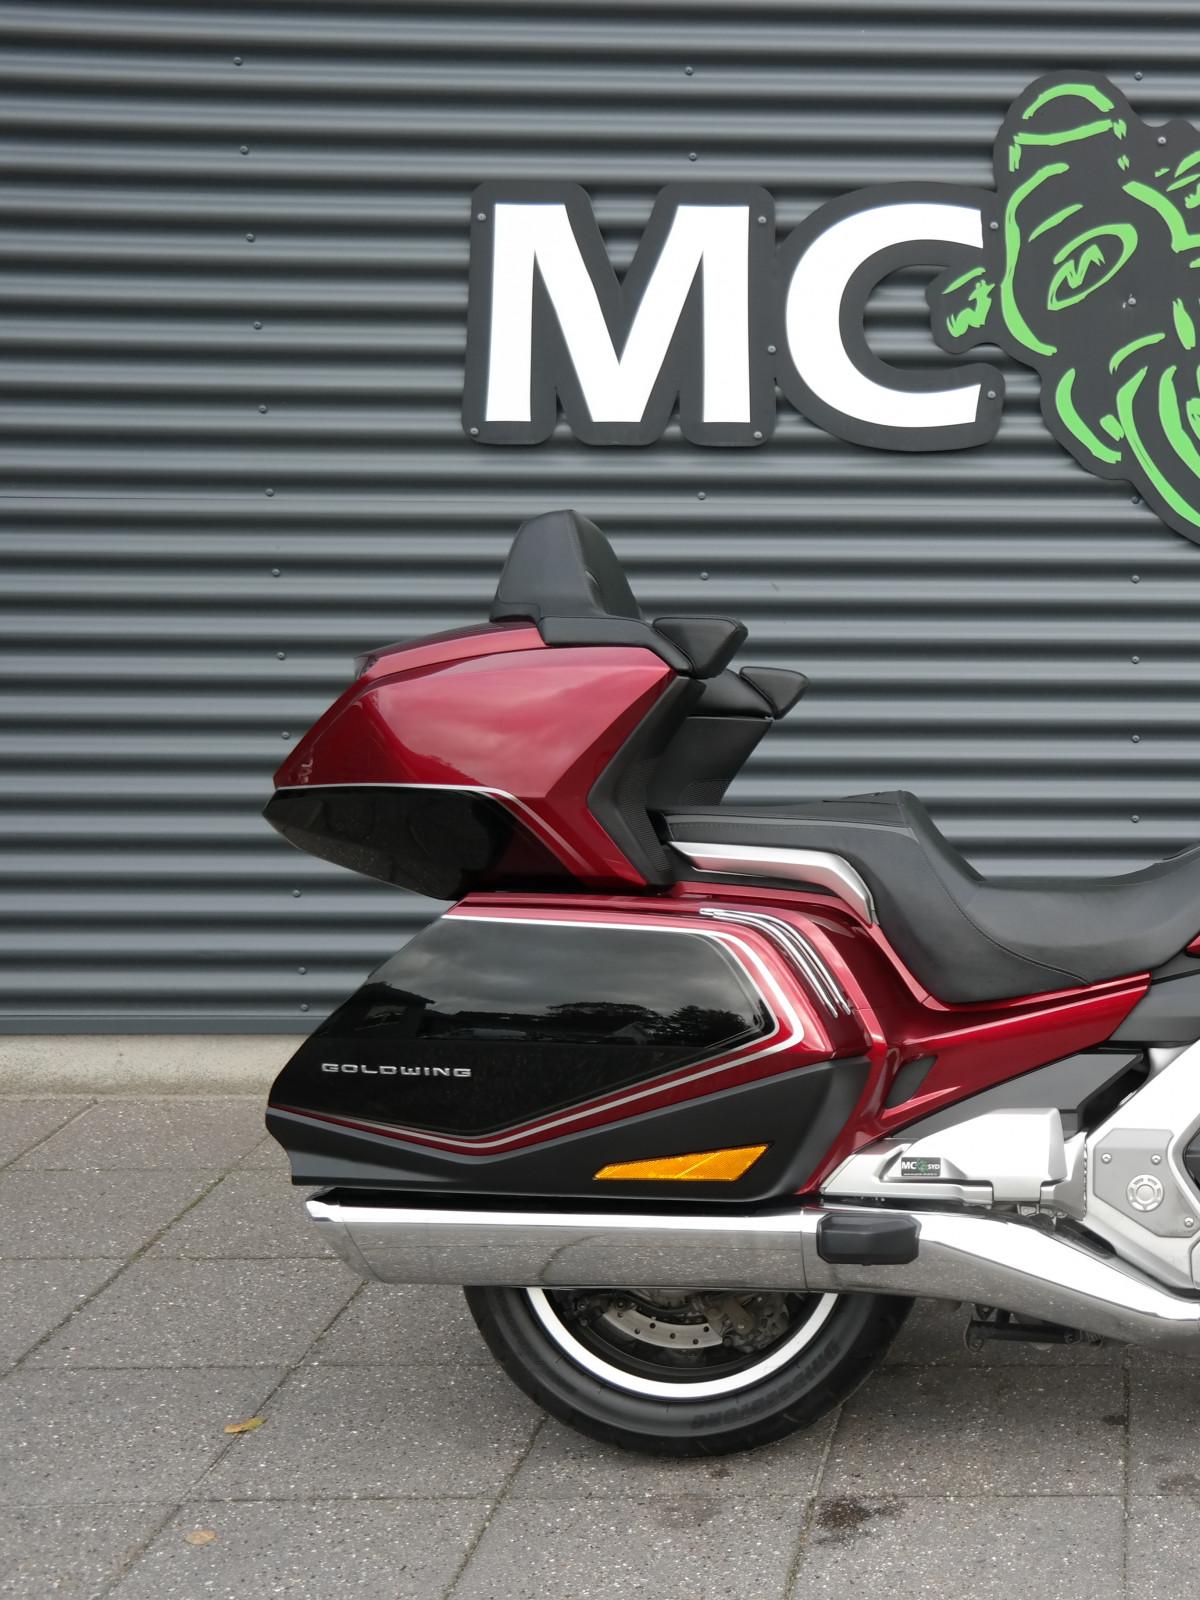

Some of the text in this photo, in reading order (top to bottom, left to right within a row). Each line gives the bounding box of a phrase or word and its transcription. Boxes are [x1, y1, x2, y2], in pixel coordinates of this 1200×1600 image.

[485, 203, 983, 427] MC
[321, 1063, 472, 1077] GOLDWING
[901, 1161, 917, 1170] MC
